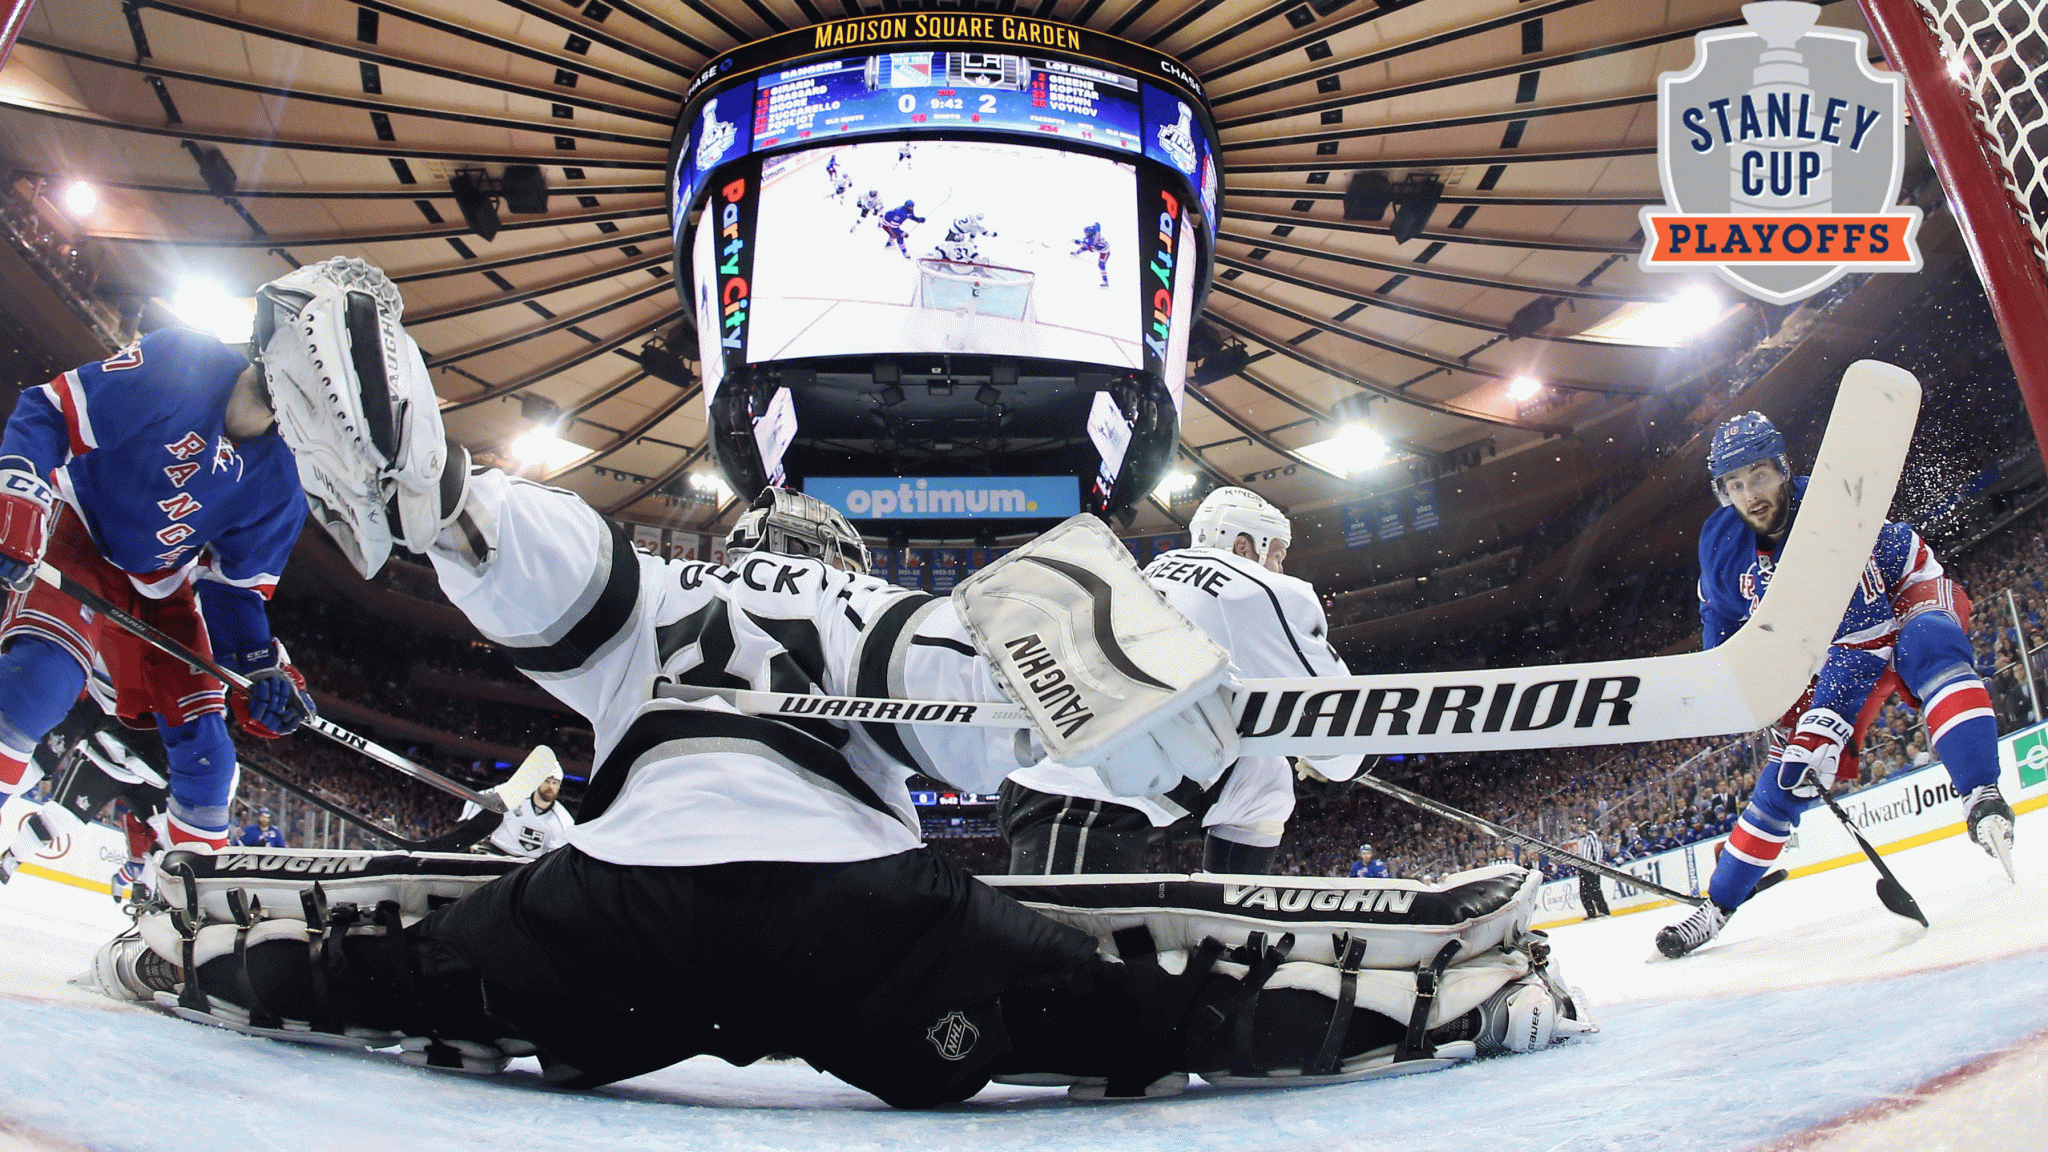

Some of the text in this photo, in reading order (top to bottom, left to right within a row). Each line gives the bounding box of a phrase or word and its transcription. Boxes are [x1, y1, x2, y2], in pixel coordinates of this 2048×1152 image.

[814, 14, 1081, 50] MADISON SQUARE GARDEN
[770, 79, 815, 96] GIRARDI
[1048, 74, 1095, 91] GREENE
[1160, 60, 1203, 96] CHASE
[1048, 83, 1100, 101] KOPITAR
[1049, 92, 1092, 108] BROWN
[768, 101, 841, 123] ZUCCARELLO
[769, 98, 808, 114] MOORE
[898, 94, 997, 114] 0 9:42 2
[1050, 101, 1098, 117] VOYNOV
[767, 113, 816, 131] POULIOT
[6, 474, 52, 504] CC
[155, 431, 207, 570] RANG
[673, 545, 695, 561] 24
[680, 558, 810, 596] QCK
[1004, 632, 1096, 740] VAUGHN
[779, 696, 978, 723] WARRIOR
[1234, 675, 1641, 739] WARRIOR
[1845, 783, 1962, 830] Edward Jone
[520, 826, 545, 842] LA
[214, 854, 374, 874] VAUGHN
[1223, 883, 1418, 914] VAUGHN
[946, 1022, 963, 1054] NHL
